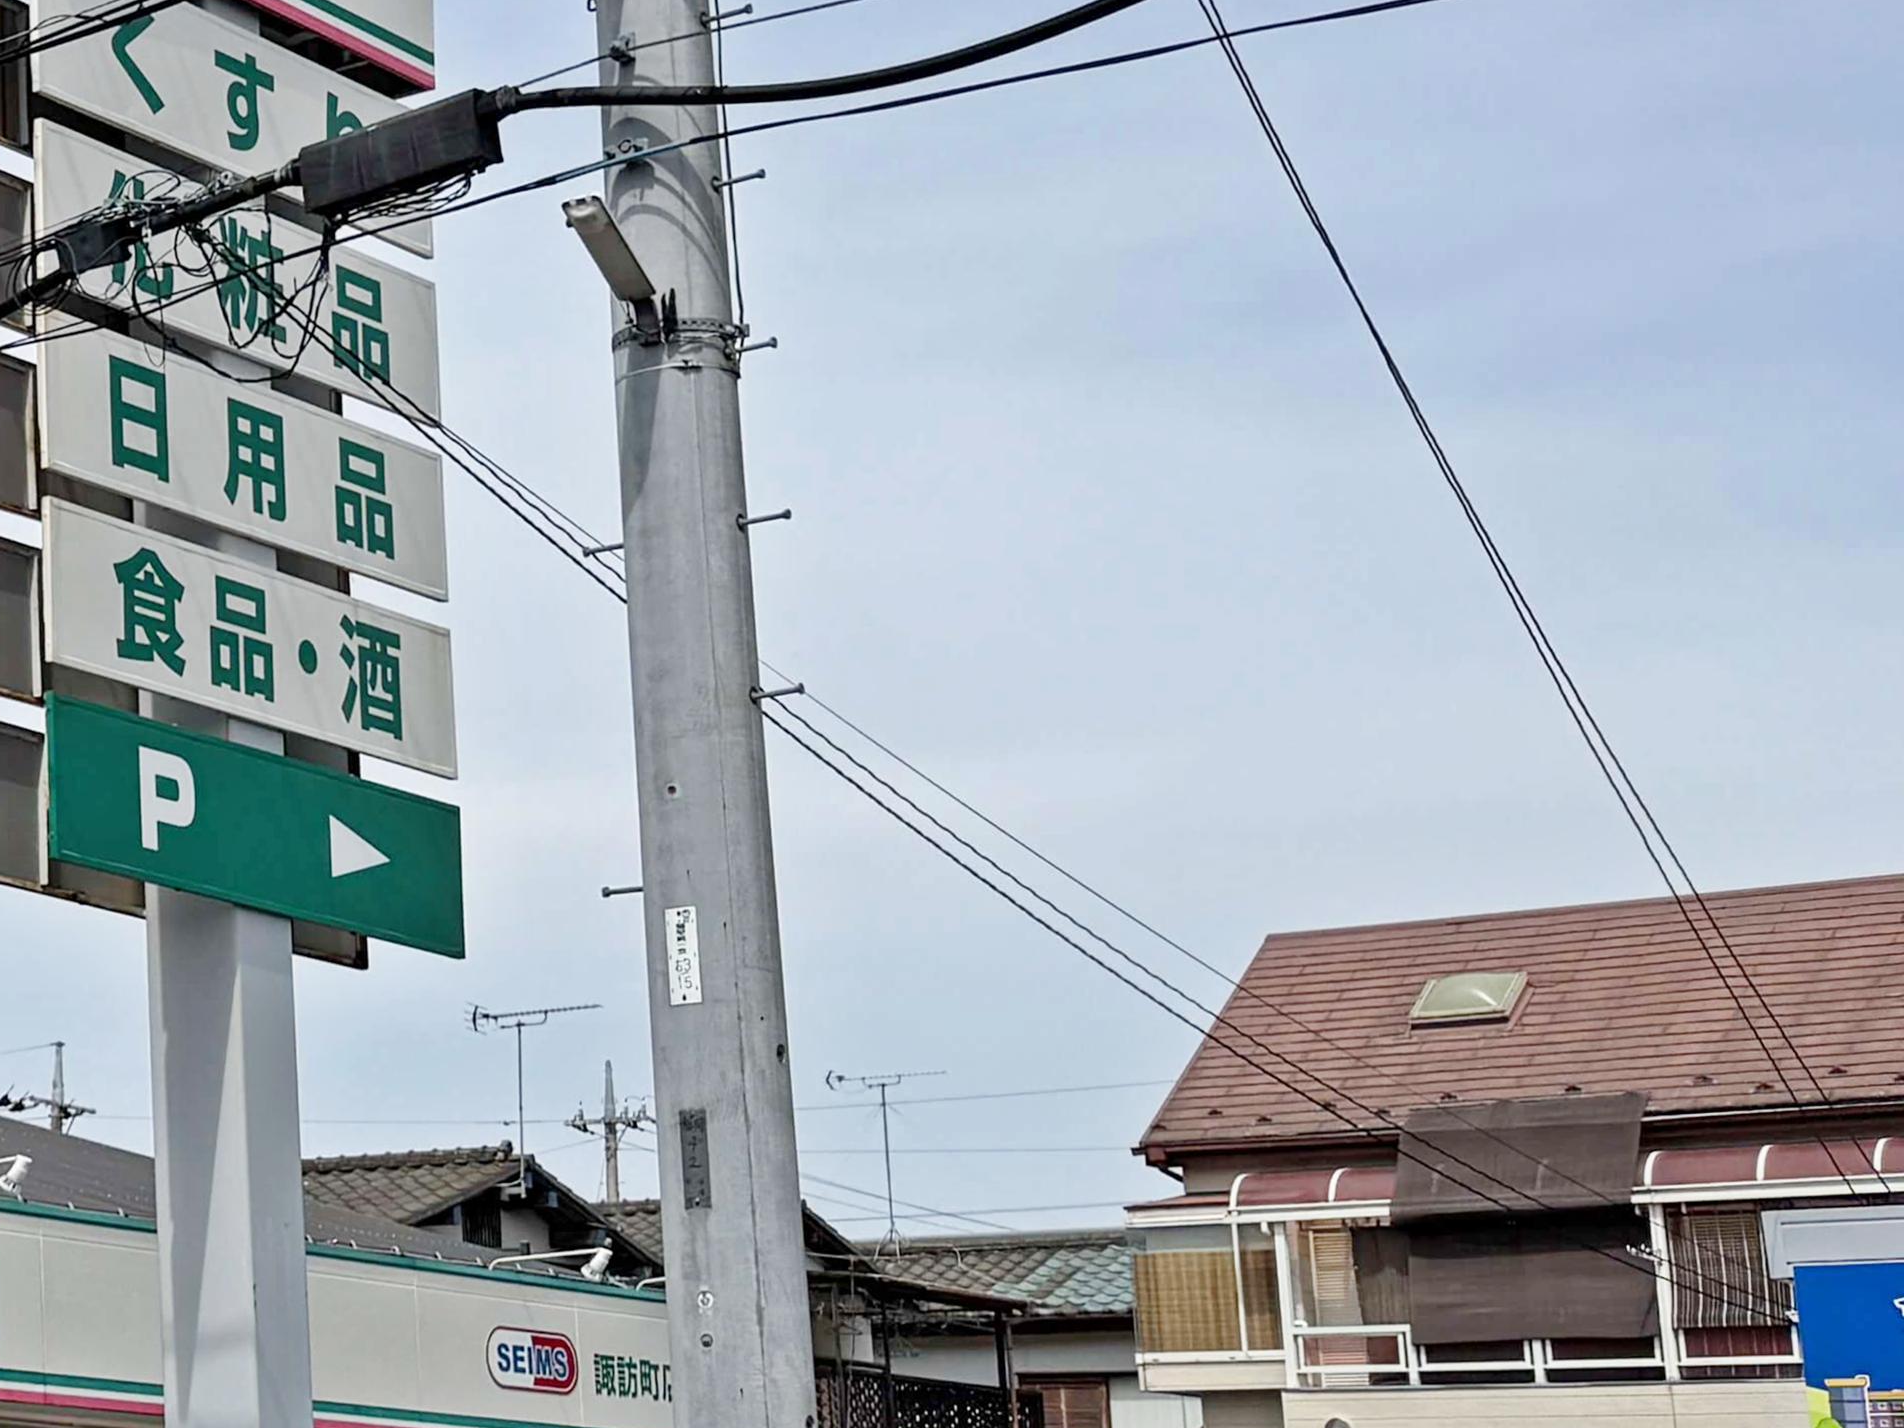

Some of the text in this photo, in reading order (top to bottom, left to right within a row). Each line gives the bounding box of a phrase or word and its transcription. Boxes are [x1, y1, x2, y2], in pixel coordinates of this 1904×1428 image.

[109, 354, 395, 560] 日用品
[114, 548, 404, 741] 食品・酒
[138, 745, 196, 851] P
[496, 1342, 569, 1380] SEIMS
